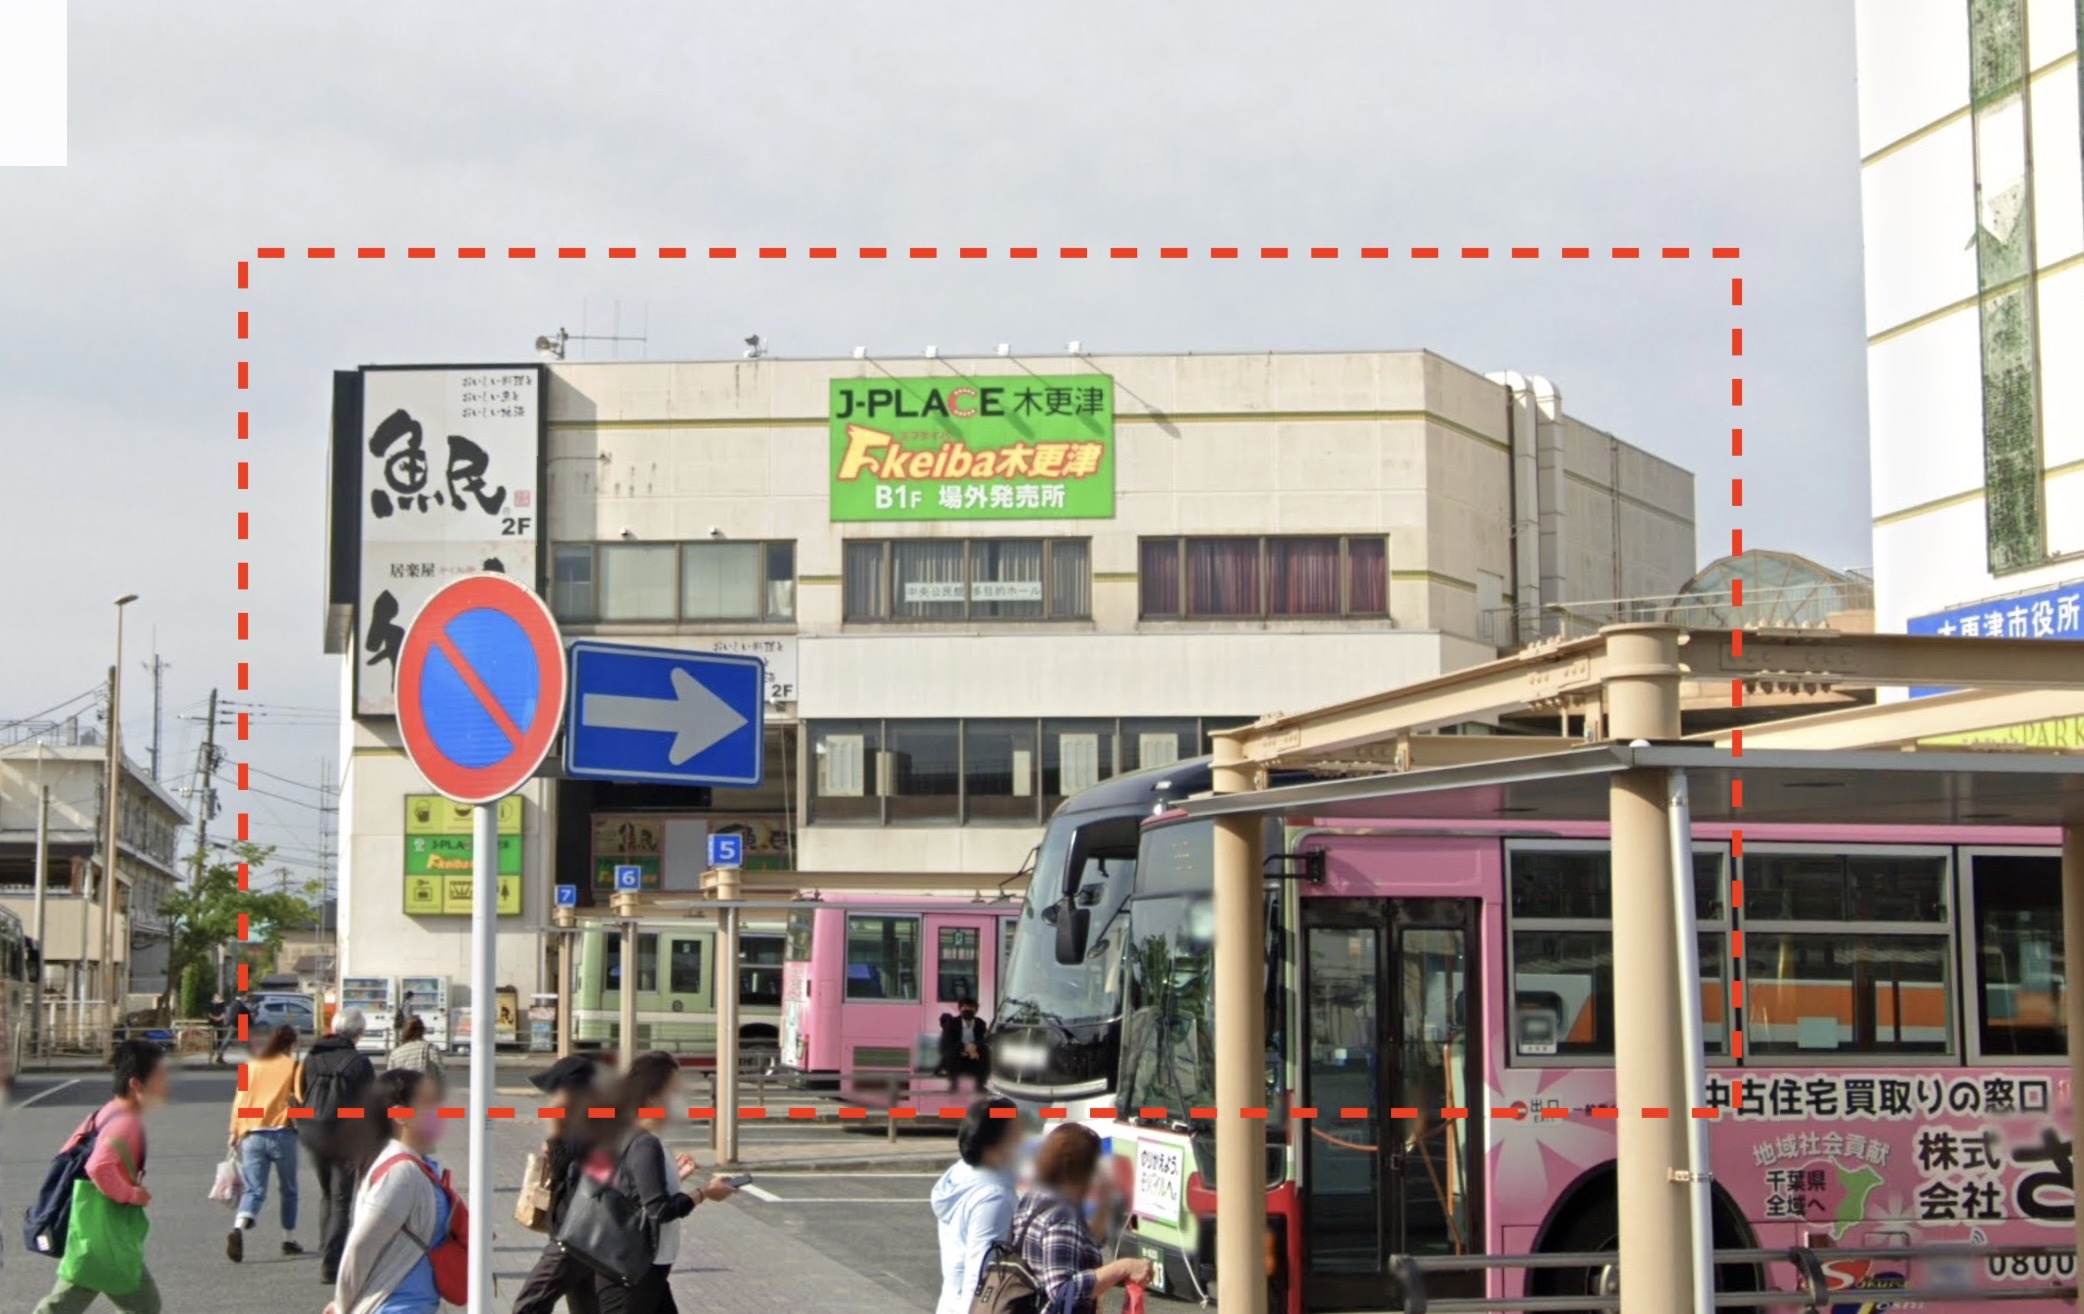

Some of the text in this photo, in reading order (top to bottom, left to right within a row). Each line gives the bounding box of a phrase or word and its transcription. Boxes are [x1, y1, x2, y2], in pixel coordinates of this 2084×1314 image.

[836, 386, 1104, 418] J-PLACE 木更津
[369, 408, 506, 519] 魚民
[875, 484, 1066, 509] B1F 場外発売所
[501, 517, 531, 535] 2F
[390, 563, 435, 577] 居楽屋
[771, 684, 793, 698] 2F
[720, 840, 735, 860] 5
[622, 871, 635, 885] 6
[560, 889, 571, 902] 7
[1705, 1079, 2049, 1116] 中古住宅買取りの窓口
[1752, 1132, 1890, 1167] 地域社会貢献
[1919, 1132, 2000, 1170] 株式
[1767, 1170, 1826, 1191] 千葉県
[1767, 1195, 1826, 1216] 全域へ
[1919, 1181, 2001, 1219] 会社
